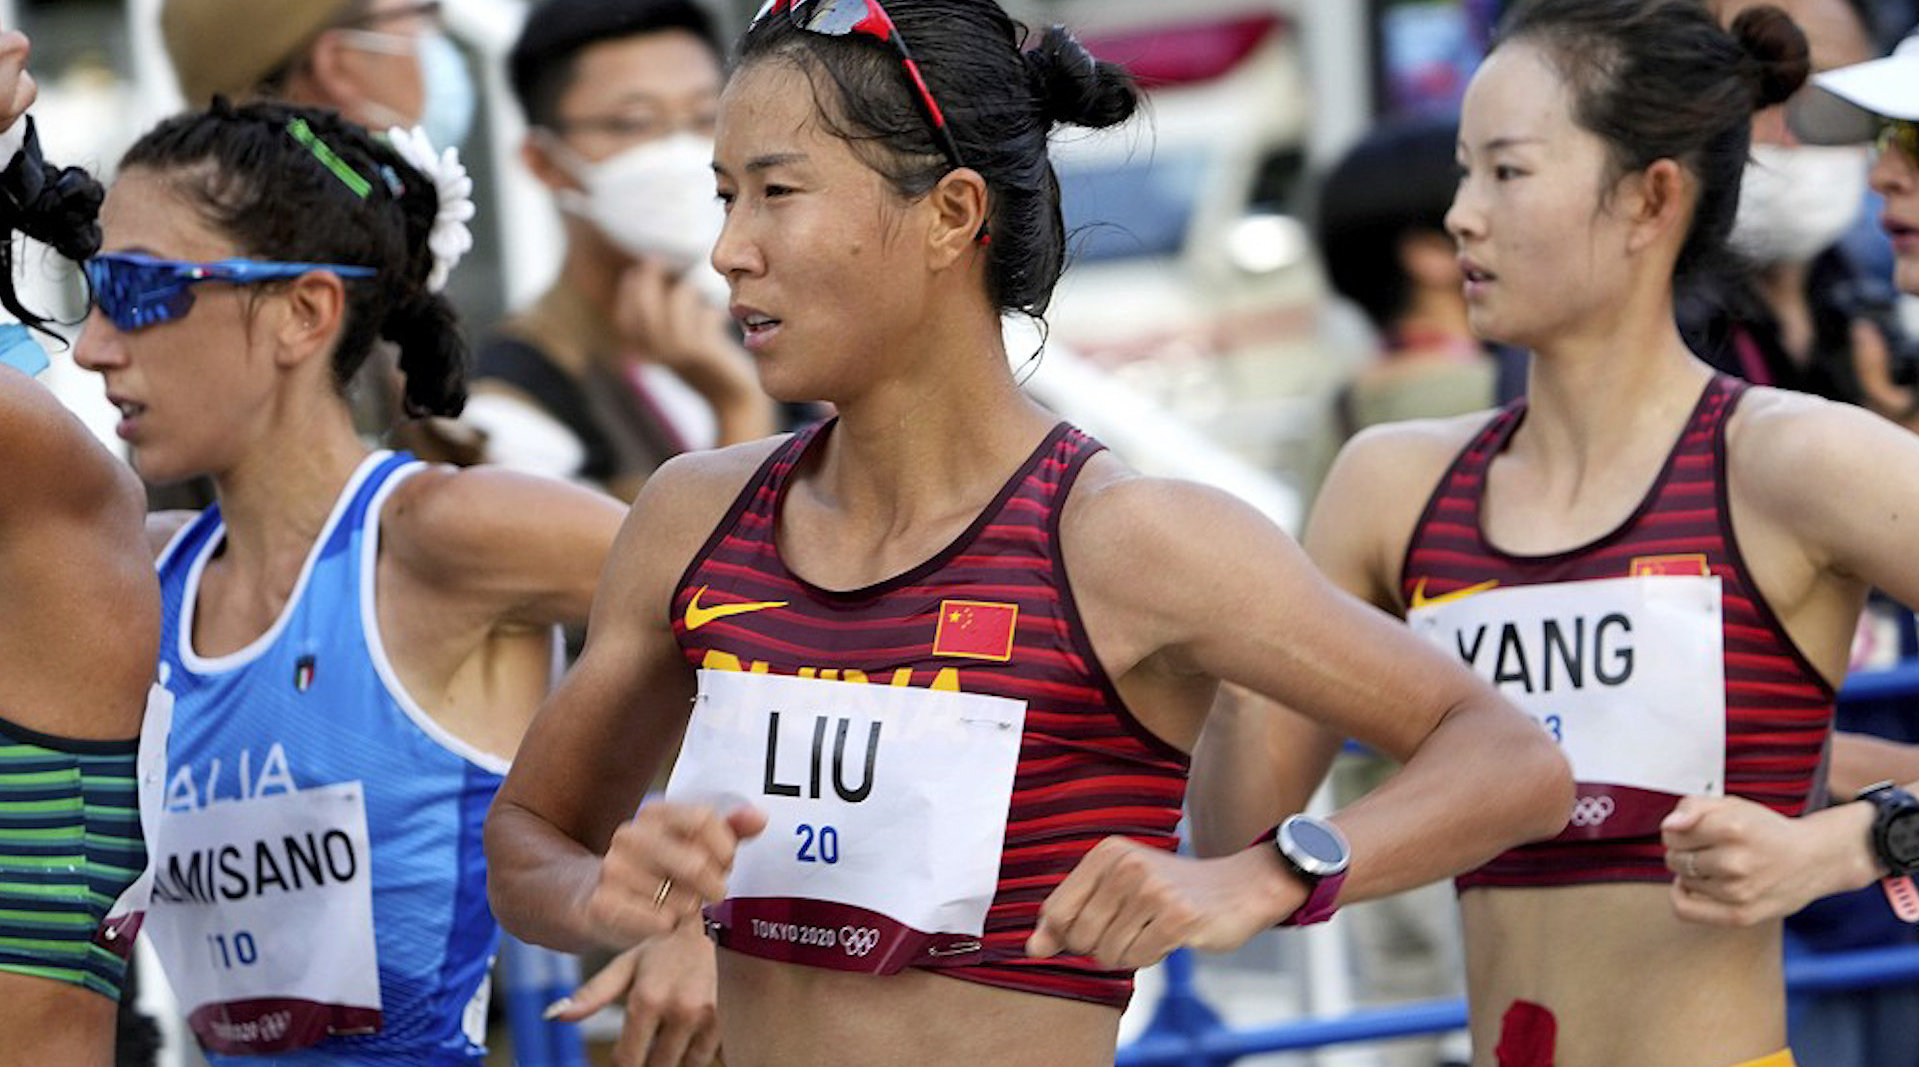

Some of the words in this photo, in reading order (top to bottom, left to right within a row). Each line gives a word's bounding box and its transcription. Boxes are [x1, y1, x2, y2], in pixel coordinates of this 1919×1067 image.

[1456, 613, 1634, 694] YANG
[764, 711, 882, 803] LIU
[796, 823, 839, 864] 20
[751, 919, 798, 942] TOKYO
[800, 925, 836, 947] 2020
